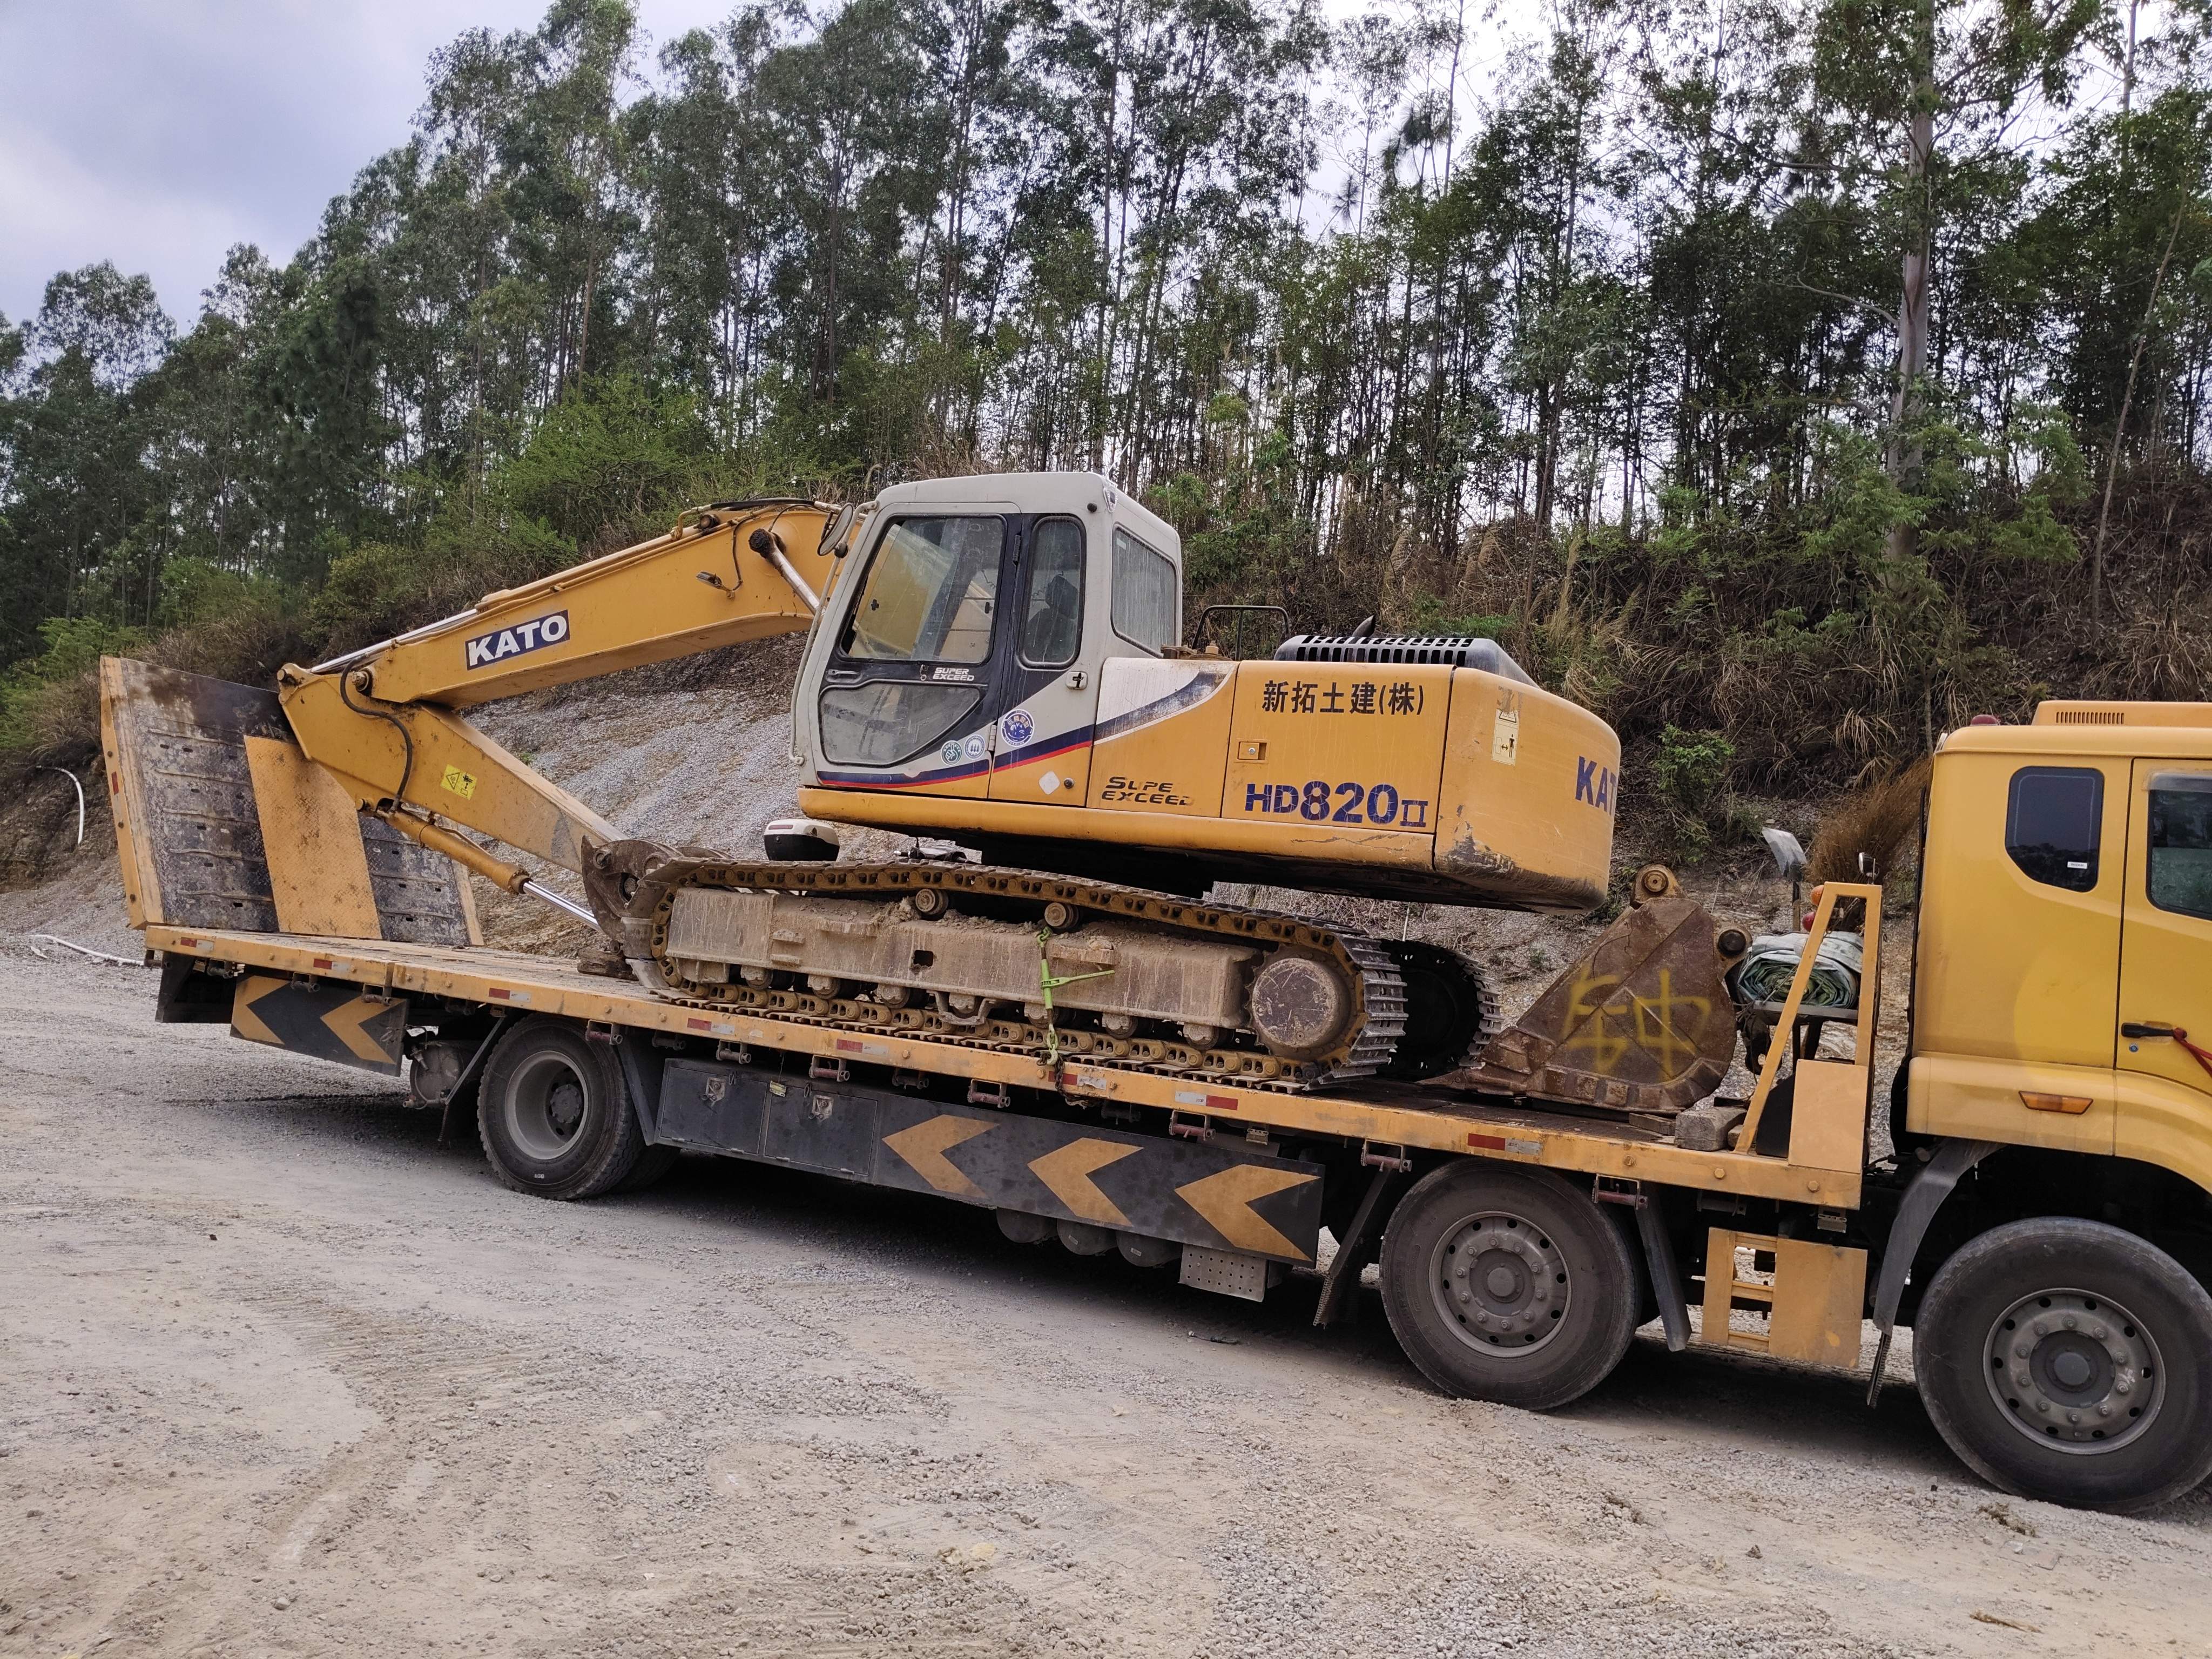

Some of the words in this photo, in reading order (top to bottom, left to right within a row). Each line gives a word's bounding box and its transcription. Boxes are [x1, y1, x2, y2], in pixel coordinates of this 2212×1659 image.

[468, 615, 567, 666] KATO
[932, 673, 975, 682] EXCEED
[1262, 680, 1424, 715] 新拓土建(株)
[1101, 790, 1195, 806] EXCEED
